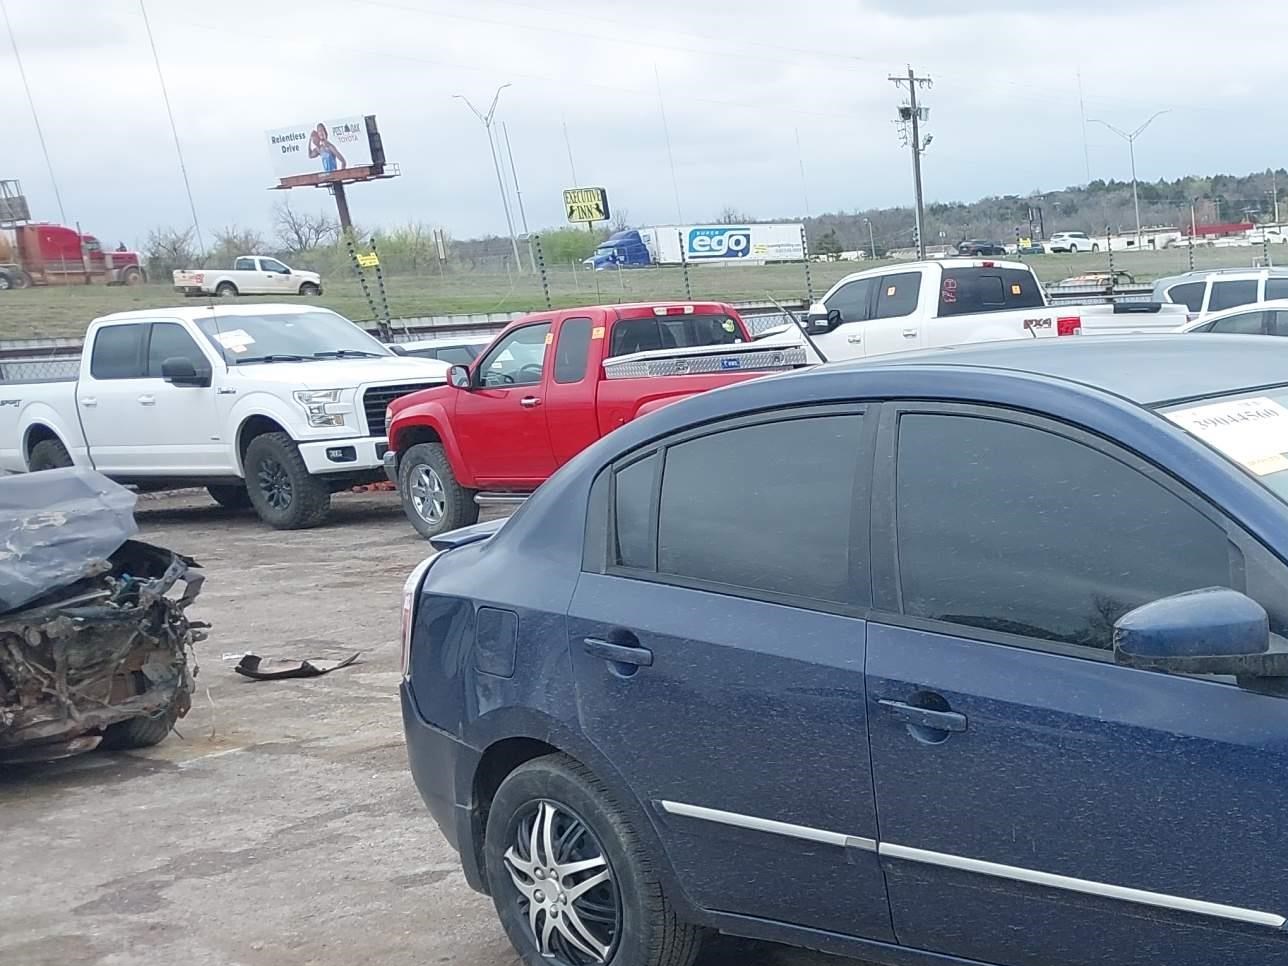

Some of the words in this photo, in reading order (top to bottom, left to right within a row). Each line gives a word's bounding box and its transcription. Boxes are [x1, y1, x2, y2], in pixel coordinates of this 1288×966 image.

[271, 132, 306, 145] Relentless
[338, 135, 359, 144] TOYOTA
[281, 145, 300, 154] Drive
[565, 189, 601, 205] EXECUTIVE
[576, 205, 594, 219] INN
[692, 234, 747, 256] ego
[1192, 407, 1280, 430] 39044560
